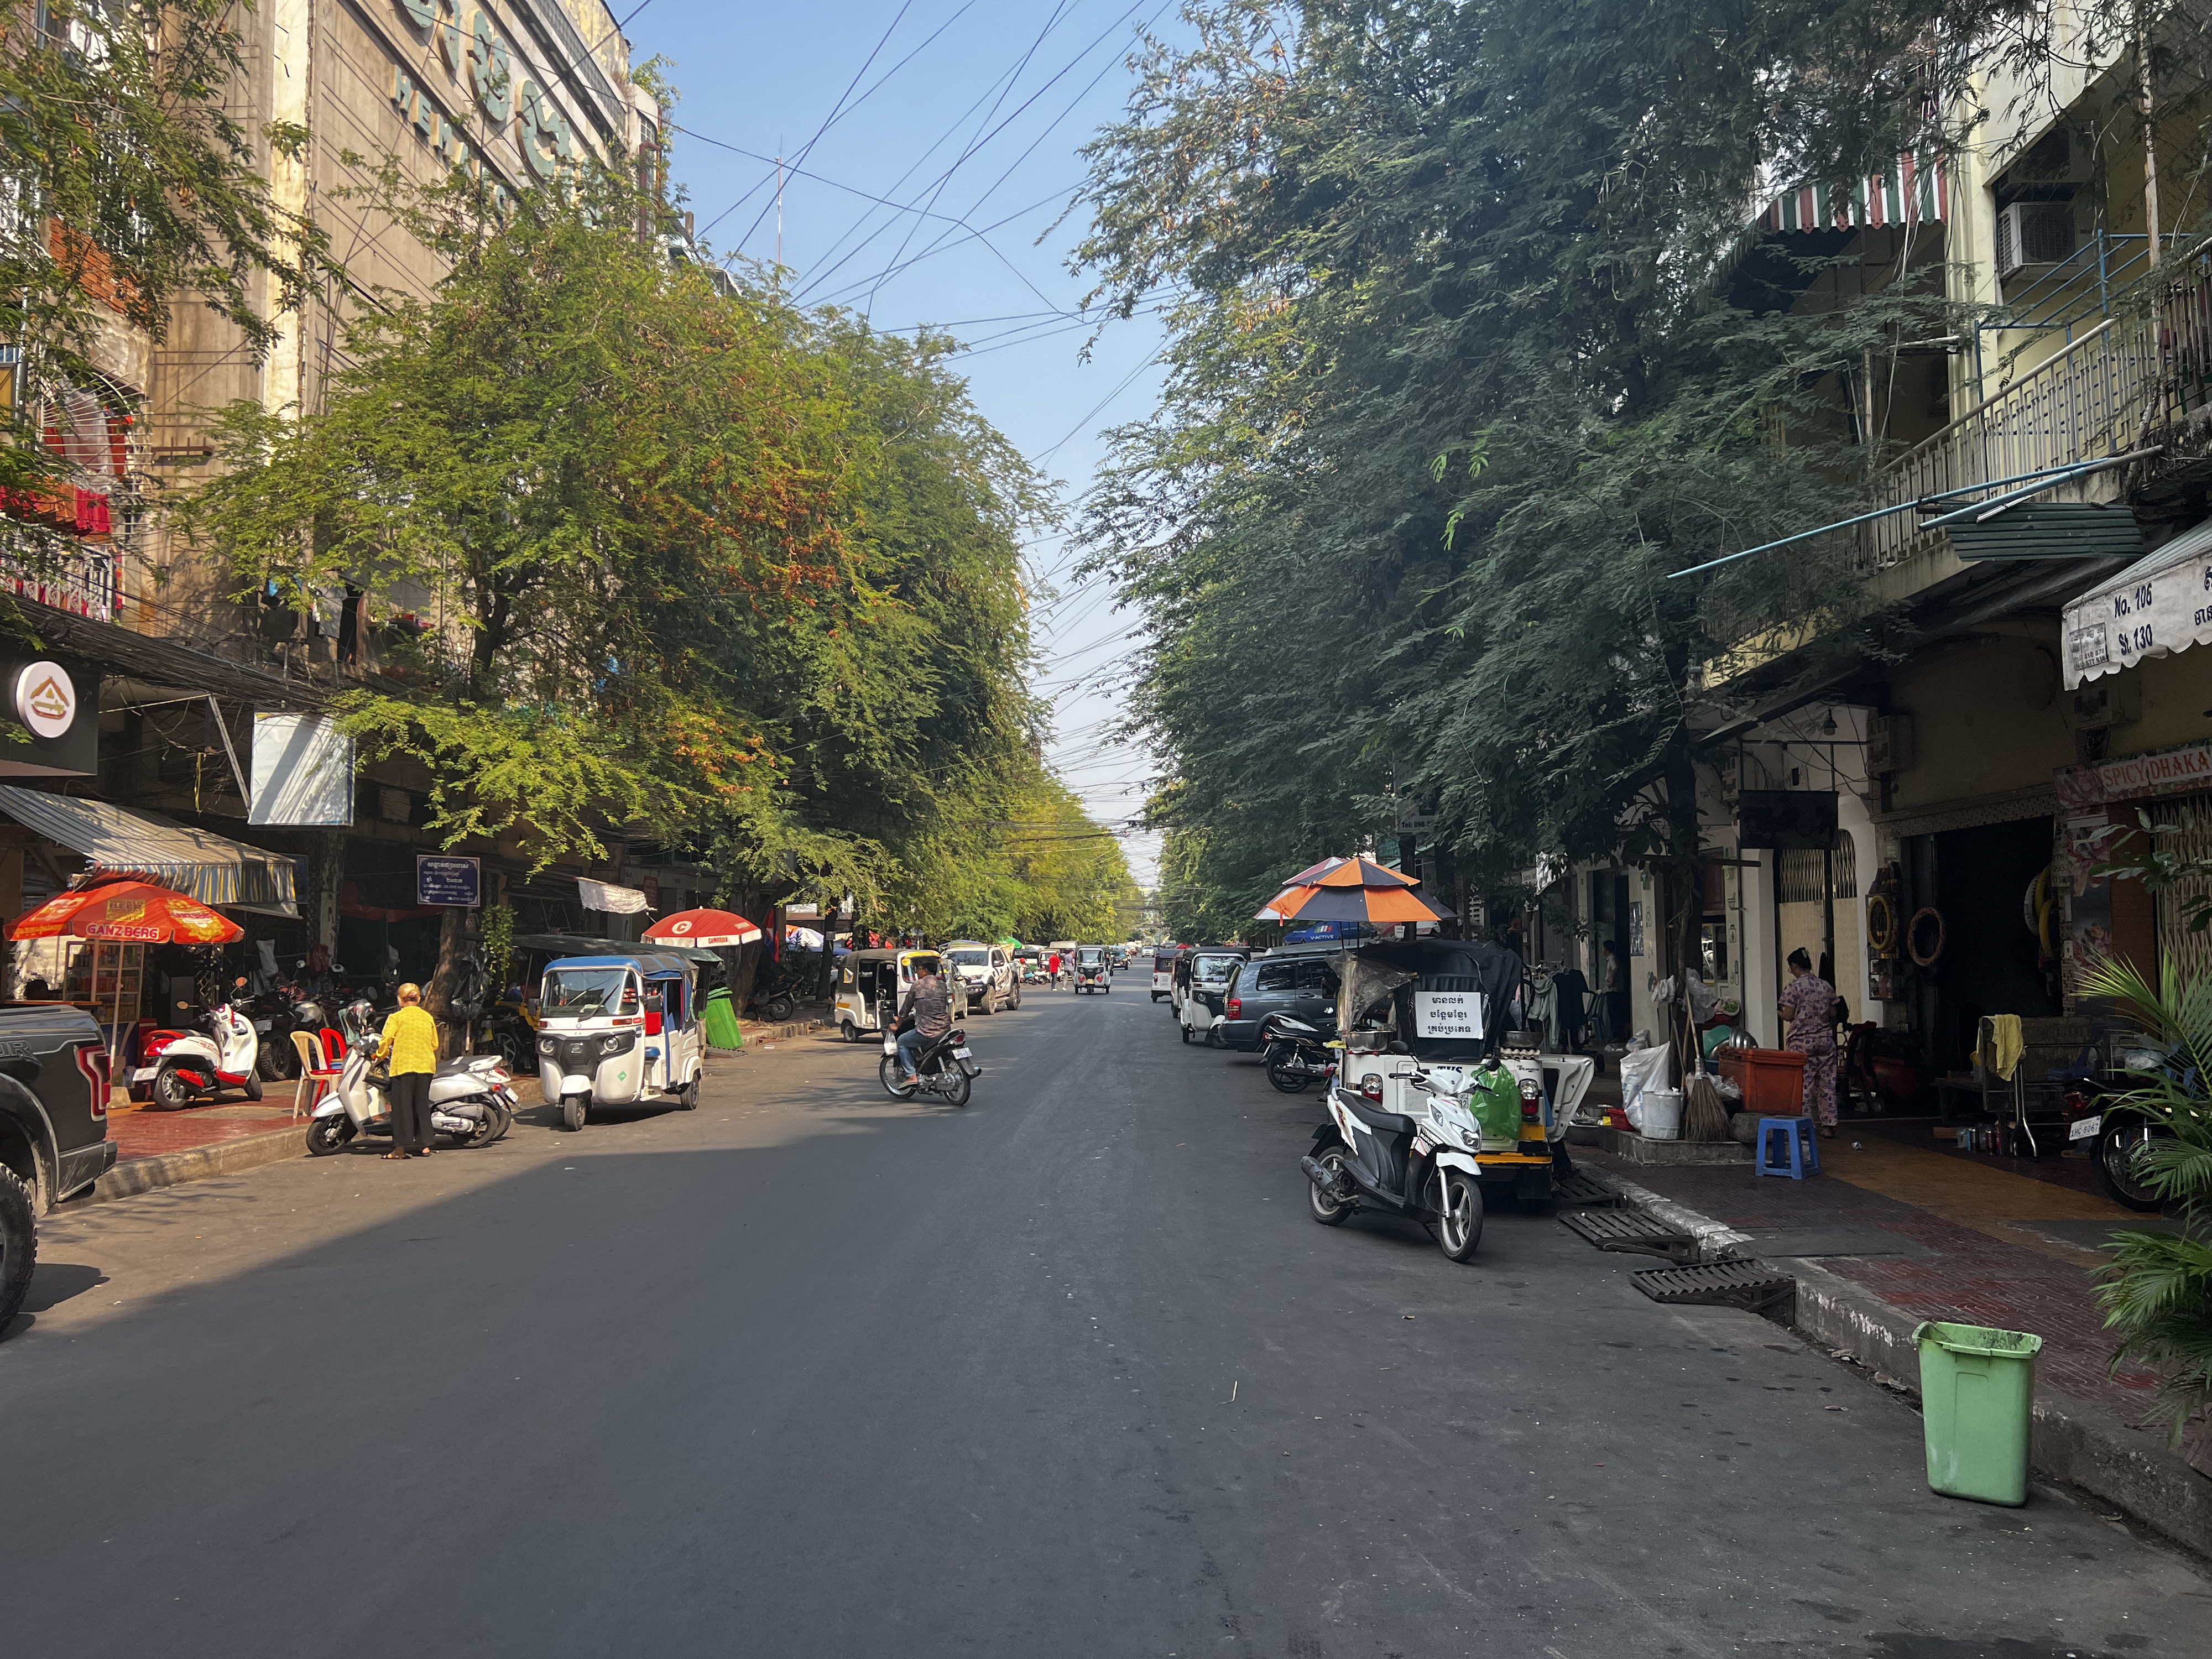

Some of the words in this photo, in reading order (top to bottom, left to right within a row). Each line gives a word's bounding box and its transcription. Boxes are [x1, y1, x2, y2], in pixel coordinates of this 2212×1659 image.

[2115, 595, 2131, 618] No.
[2136, 583, 2152, 610] 106
[2119, 633, 2132, 655] St.
[2133, 624, 2153, 650] 130
[2103, 758, 2145, 787] SPICY
[2149, 751, 2211, 780] DHAKA
[86, 923, 159, 940] GANZBERG
